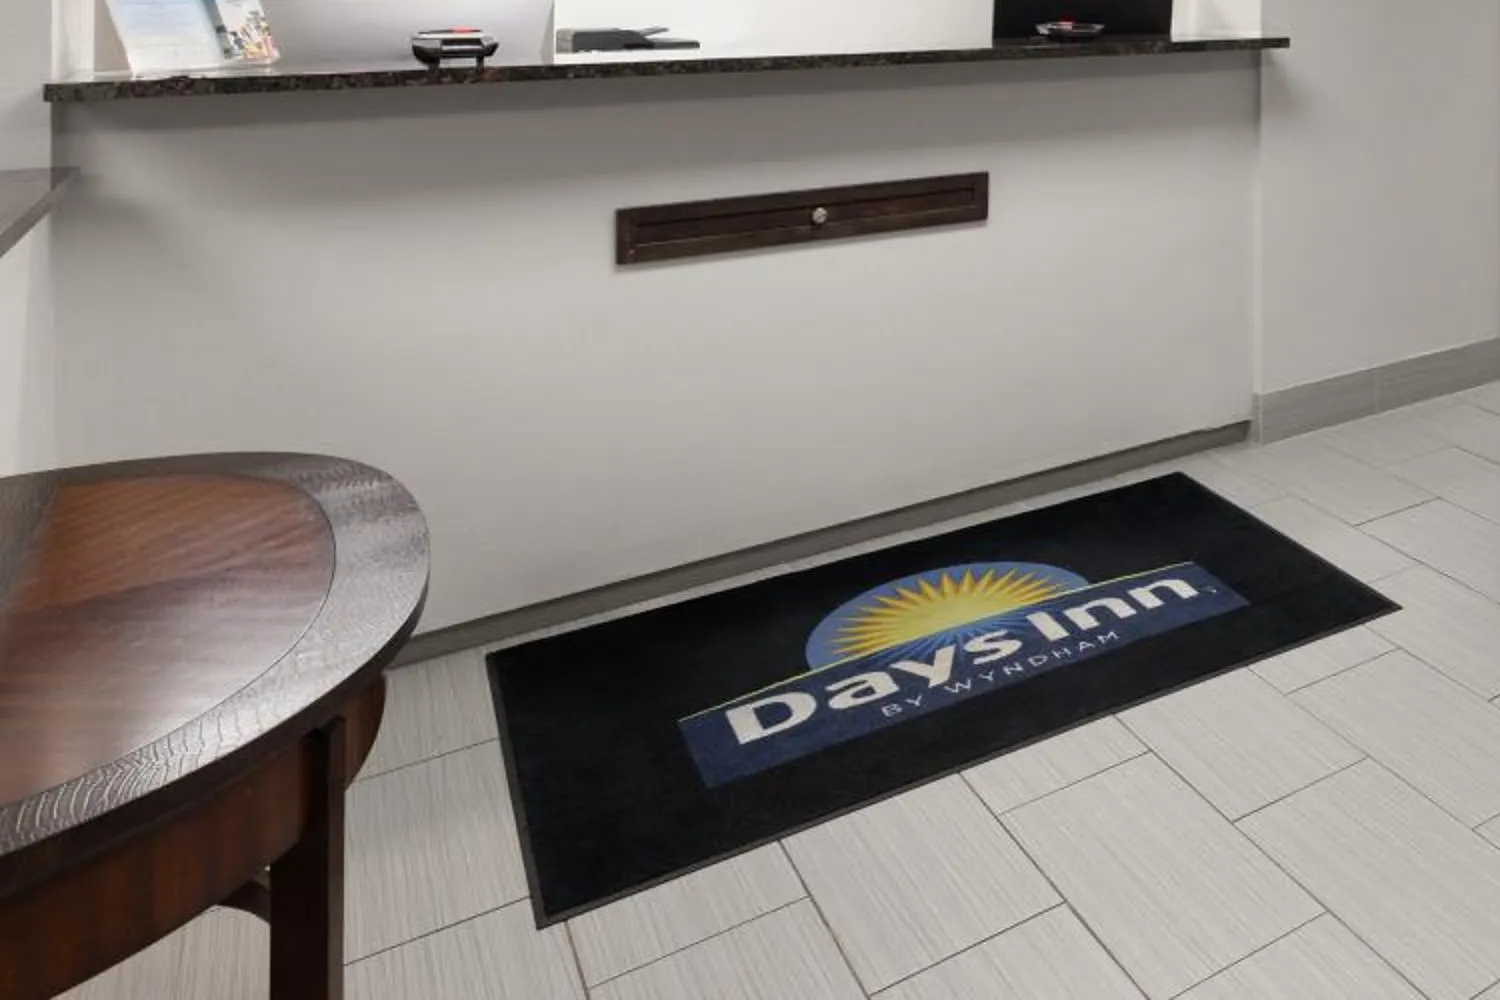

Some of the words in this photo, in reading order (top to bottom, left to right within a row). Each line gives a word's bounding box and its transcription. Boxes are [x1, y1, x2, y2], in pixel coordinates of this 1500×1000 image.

[725, 631, 1023, 745] Days
[1026, 574, 1199, 641] Inn
[882, 693, 922, 718] BY
[943, 630, 1120, 695] WYNDHAM
